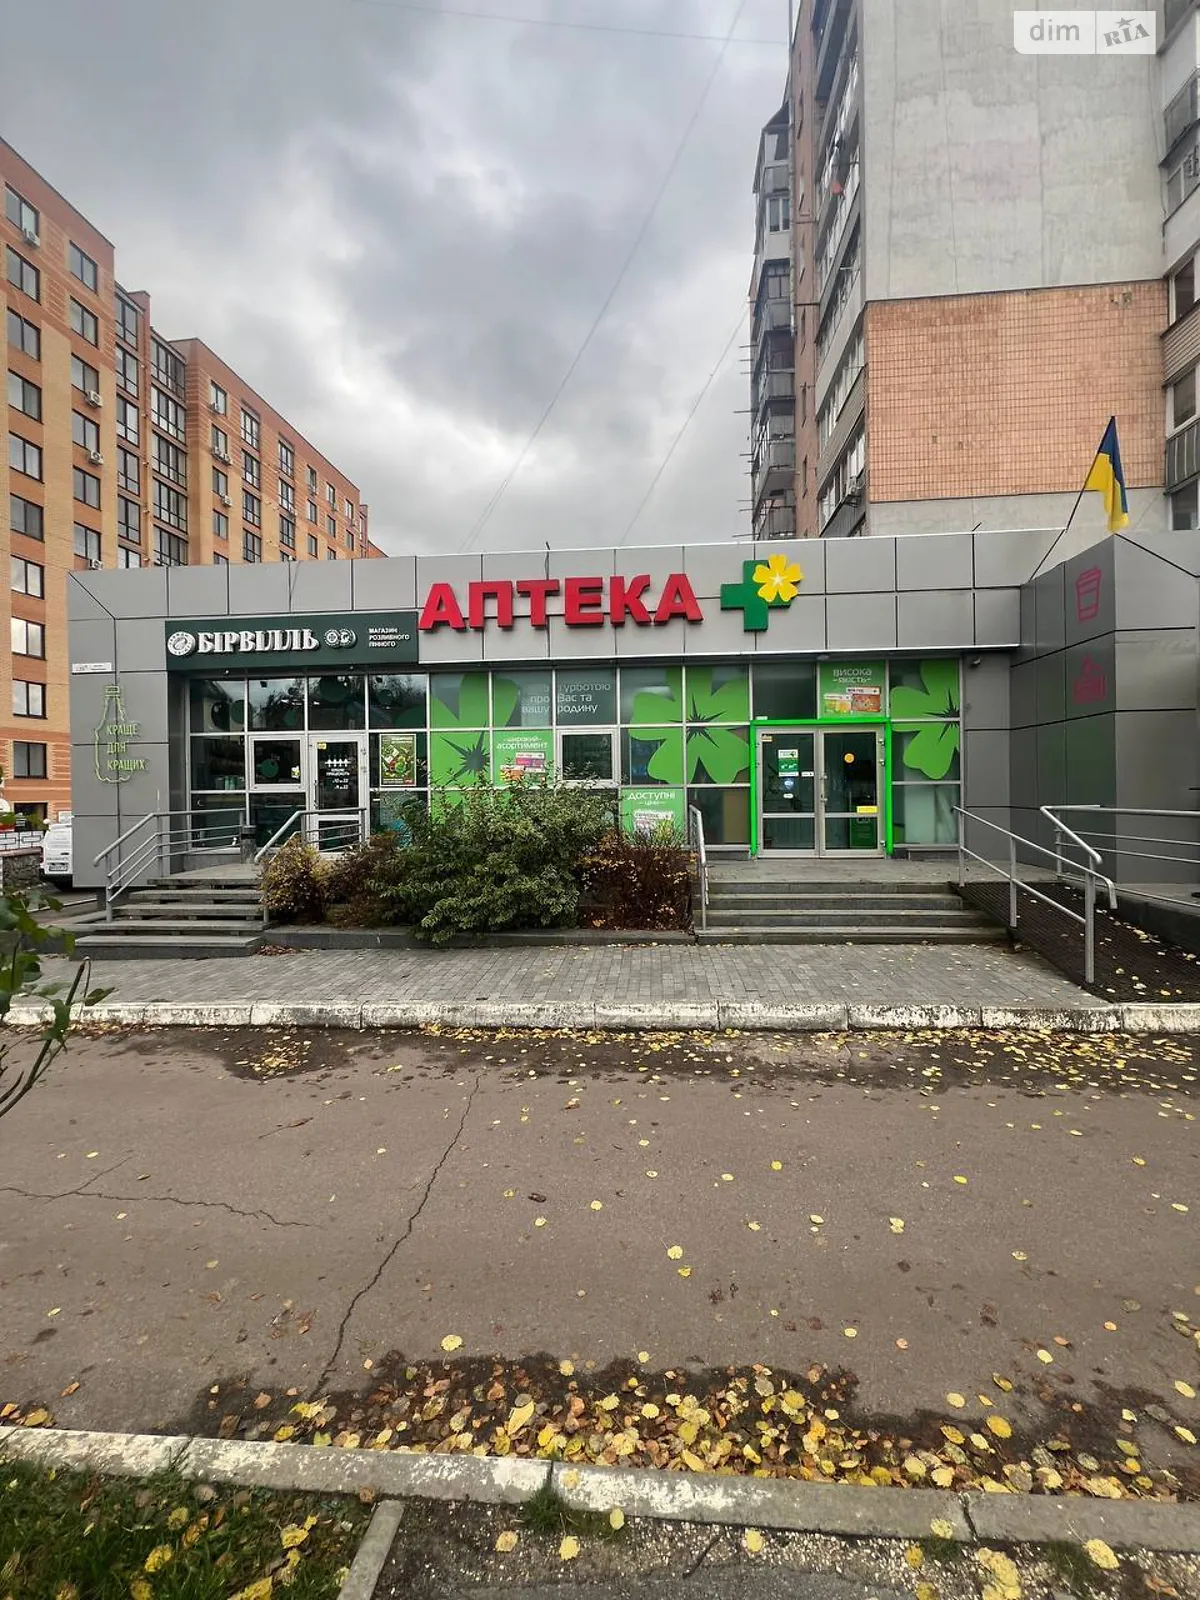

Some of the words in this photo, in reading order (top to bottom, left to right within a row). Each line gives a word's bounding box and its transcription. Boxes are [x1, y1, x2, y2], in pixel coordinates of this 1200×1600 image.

[417, 573, 704, 631] АПТЕКА
[197, 628, 320, 653] БІРВІЛЛЬ
[580, 694, 592, 702] та
[106, 741, 126, 754] ДЛЯ
[107, 759, 145, 771] КРАЩИХ
